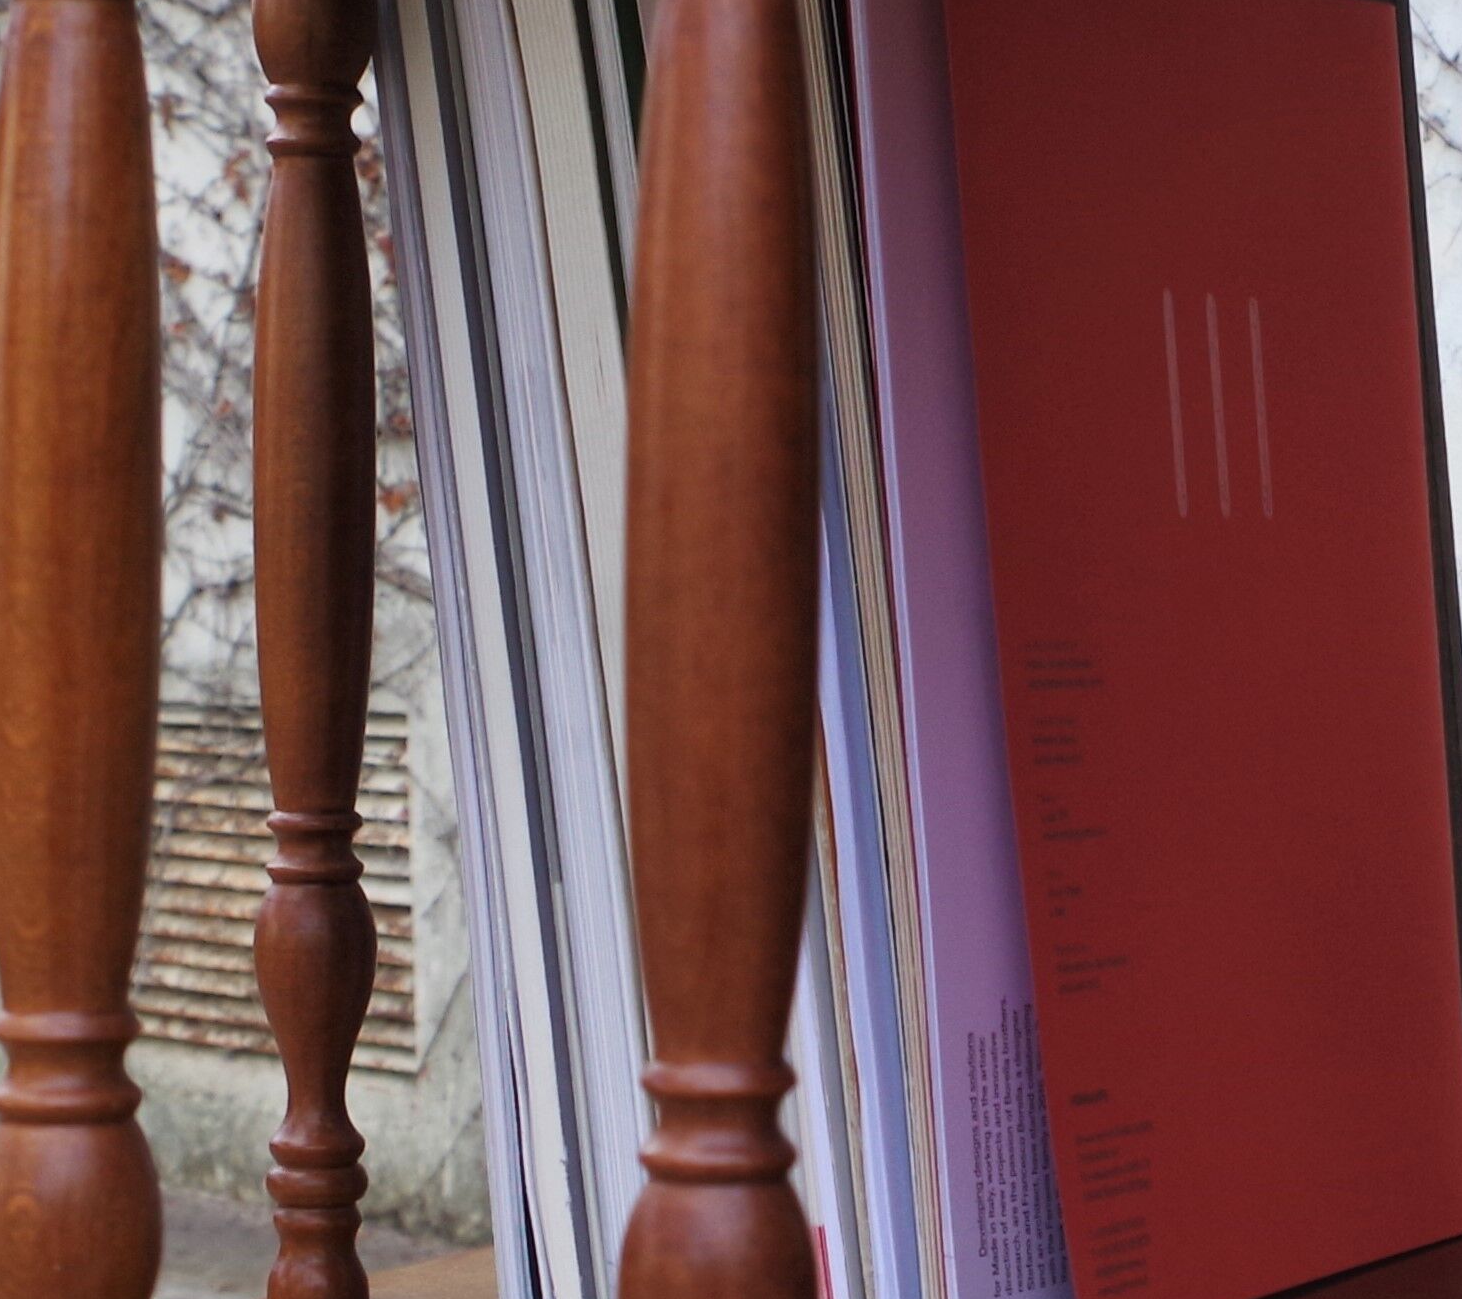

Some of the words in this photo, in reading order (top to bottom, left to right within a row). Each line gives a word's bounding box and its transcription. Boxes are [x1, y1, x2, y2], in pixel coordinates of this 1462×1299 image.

[967, 1032, 978, 1093] solutions
[1013, 1009, 1022, 1067] designer
[1024, 1003, 1033, 1091] collaborating
[970, 1096, 978, 1121] and
[993, 1103, 1001, 1128] and
[1028, 1093, 1036, 1139] started
[972, 1126, 982, 1178] designs
[984, 1131, 993, 1185] working
[995, 1132, 1006, 1185] projects
[1007, 1126, 1017, 1177] passion
[1019, 1136, 1028, 1206] Francesco
[976, 1181, 987, 1257] Developing
[1023, 1211, 1031, 1235] and
[991, 1238, 999, 1276] Made
[1003, 1238, 1012, 1296] direction
[1026, 1239, 1035, 1291] Stefano
